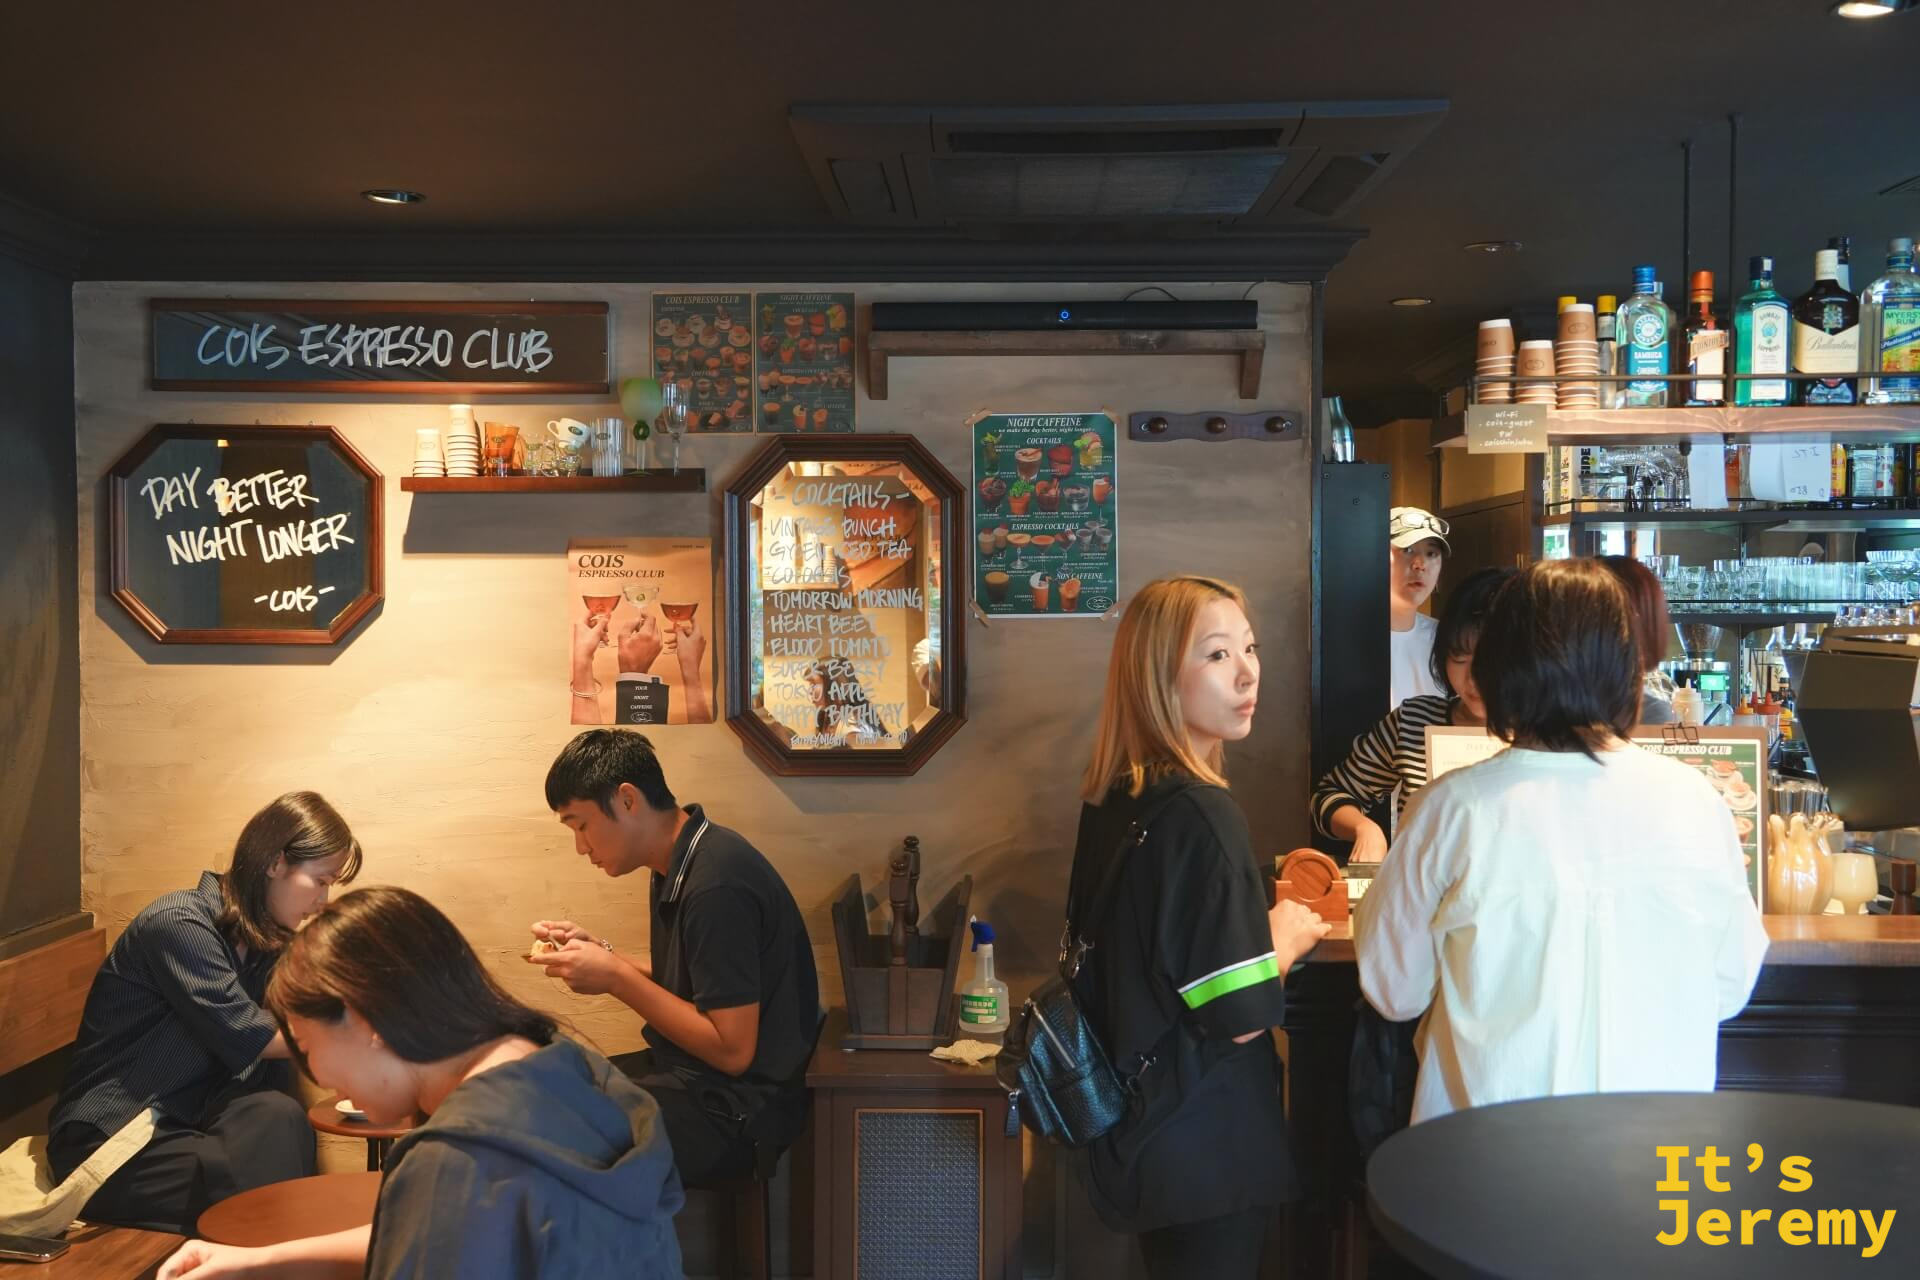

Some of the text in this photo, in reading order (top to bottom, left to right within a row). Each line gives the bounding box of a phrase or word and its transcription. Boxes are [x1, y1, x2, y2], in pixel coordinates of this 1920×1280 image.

[683, 296, 719, 304] ESPRESSO
[199, 322, 554, 373] COIS ESPRESSO CLUB
[1007, 417, 1082, 427] NIGHT CAFFEINE
[1026, 437, 1062, 445] COCKTAILS
[140, 466, 320, 520] DAY BETTER
[792, 481, 890, 510] COCKTAILS
[1044, 522, 1080, 530] COCKTAILS
[166, 512, 355, 566] NIGHT LONGER
[877, 538, 912, 561] TEA
[578, 554, 625, 568] COIS
[578, 570, 665, 578] ESPRESSO CLUB
[1071, 572, 1104, 580] CAFFEINE
[770, 588, 924, 612] TOMORROW MORNING
[770, 613, 826, 634] HEART
[770, 636, 893, 658] BLOOD TOMATO
[770, 658, 824, 679] SUPER
[774, 681, 877, 703] TOKYO APPLE
[773, 703, 821, 728] HAPPY
[1663, 745, 1707, 754] ESPRESSO
[1708, 745, 1732, 755] CLUB
